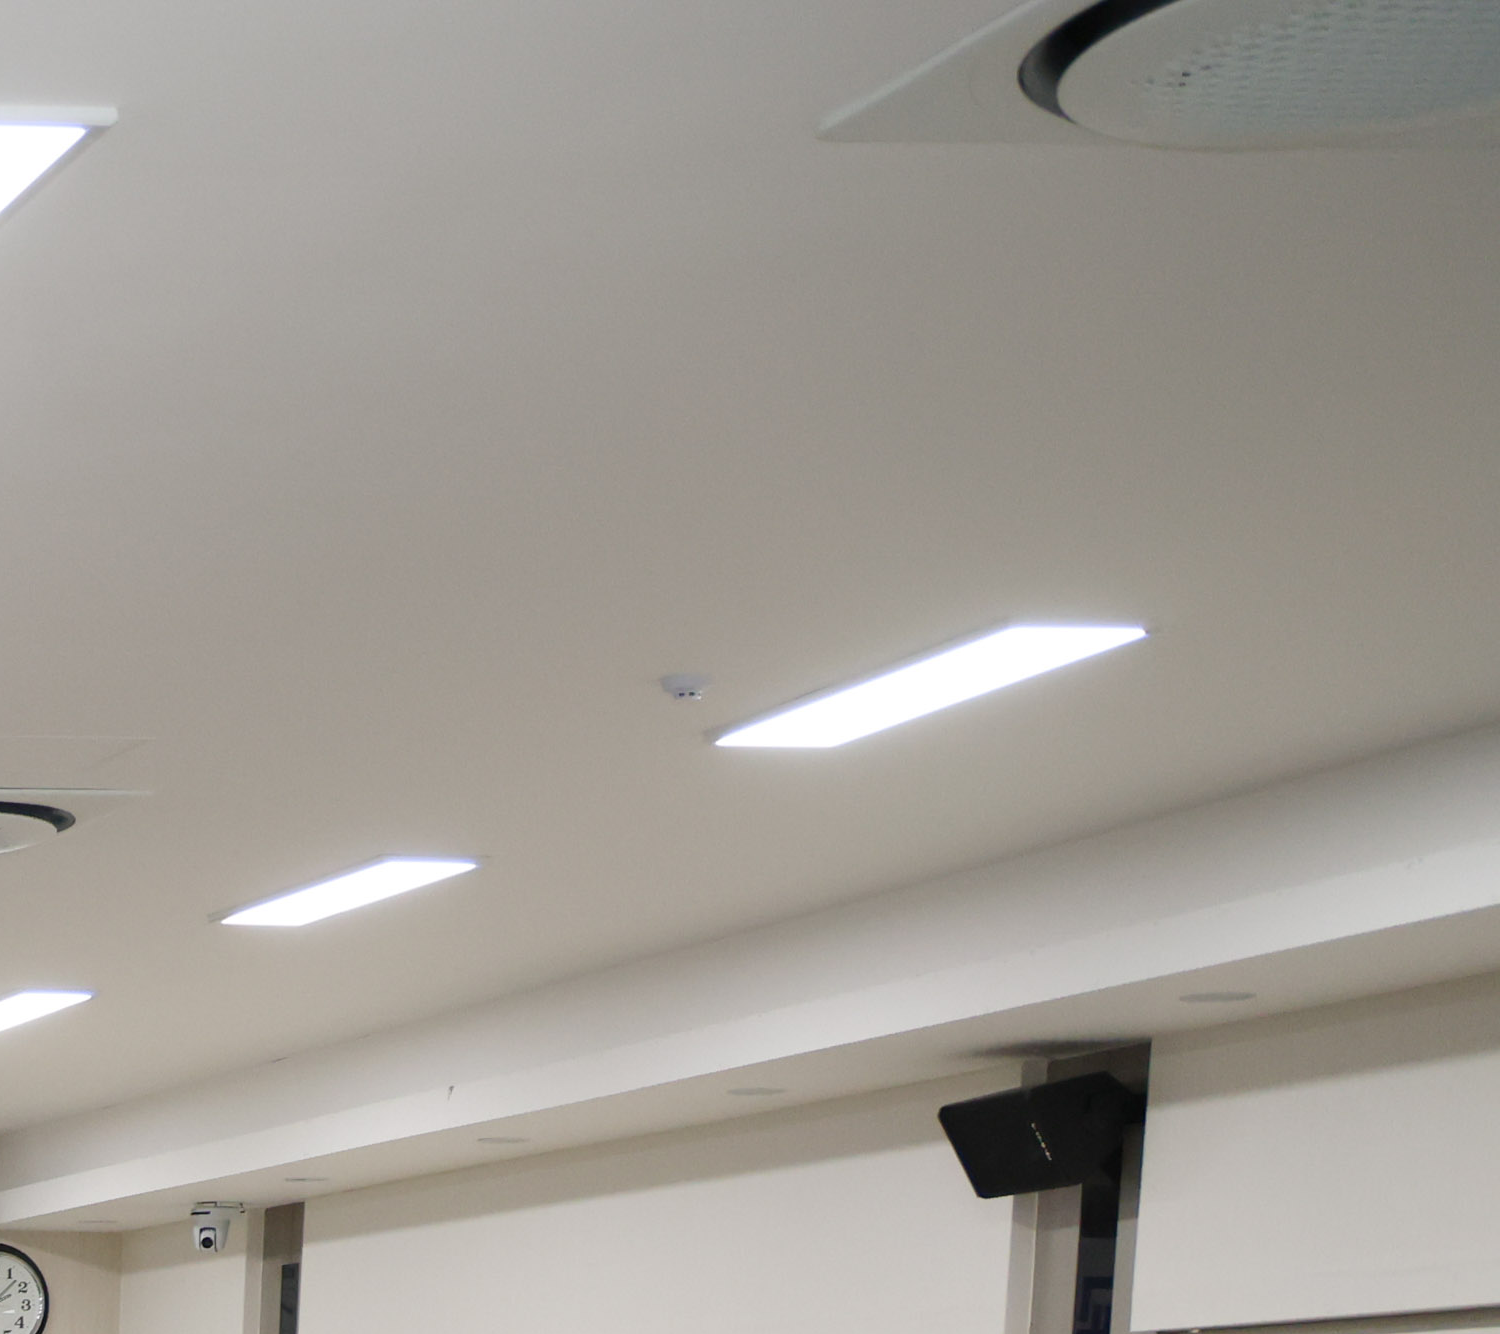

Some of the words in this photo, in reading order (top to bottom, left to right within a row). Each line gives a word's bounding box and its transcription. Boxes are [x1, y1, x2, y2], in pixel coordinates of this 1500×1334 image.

[7, 1268, 12, 1279] 1
[18, 1281, 28, 1293] 2
[21, 1299, 31, 1311] 3
[14, 1316, 25, 1329] 4
